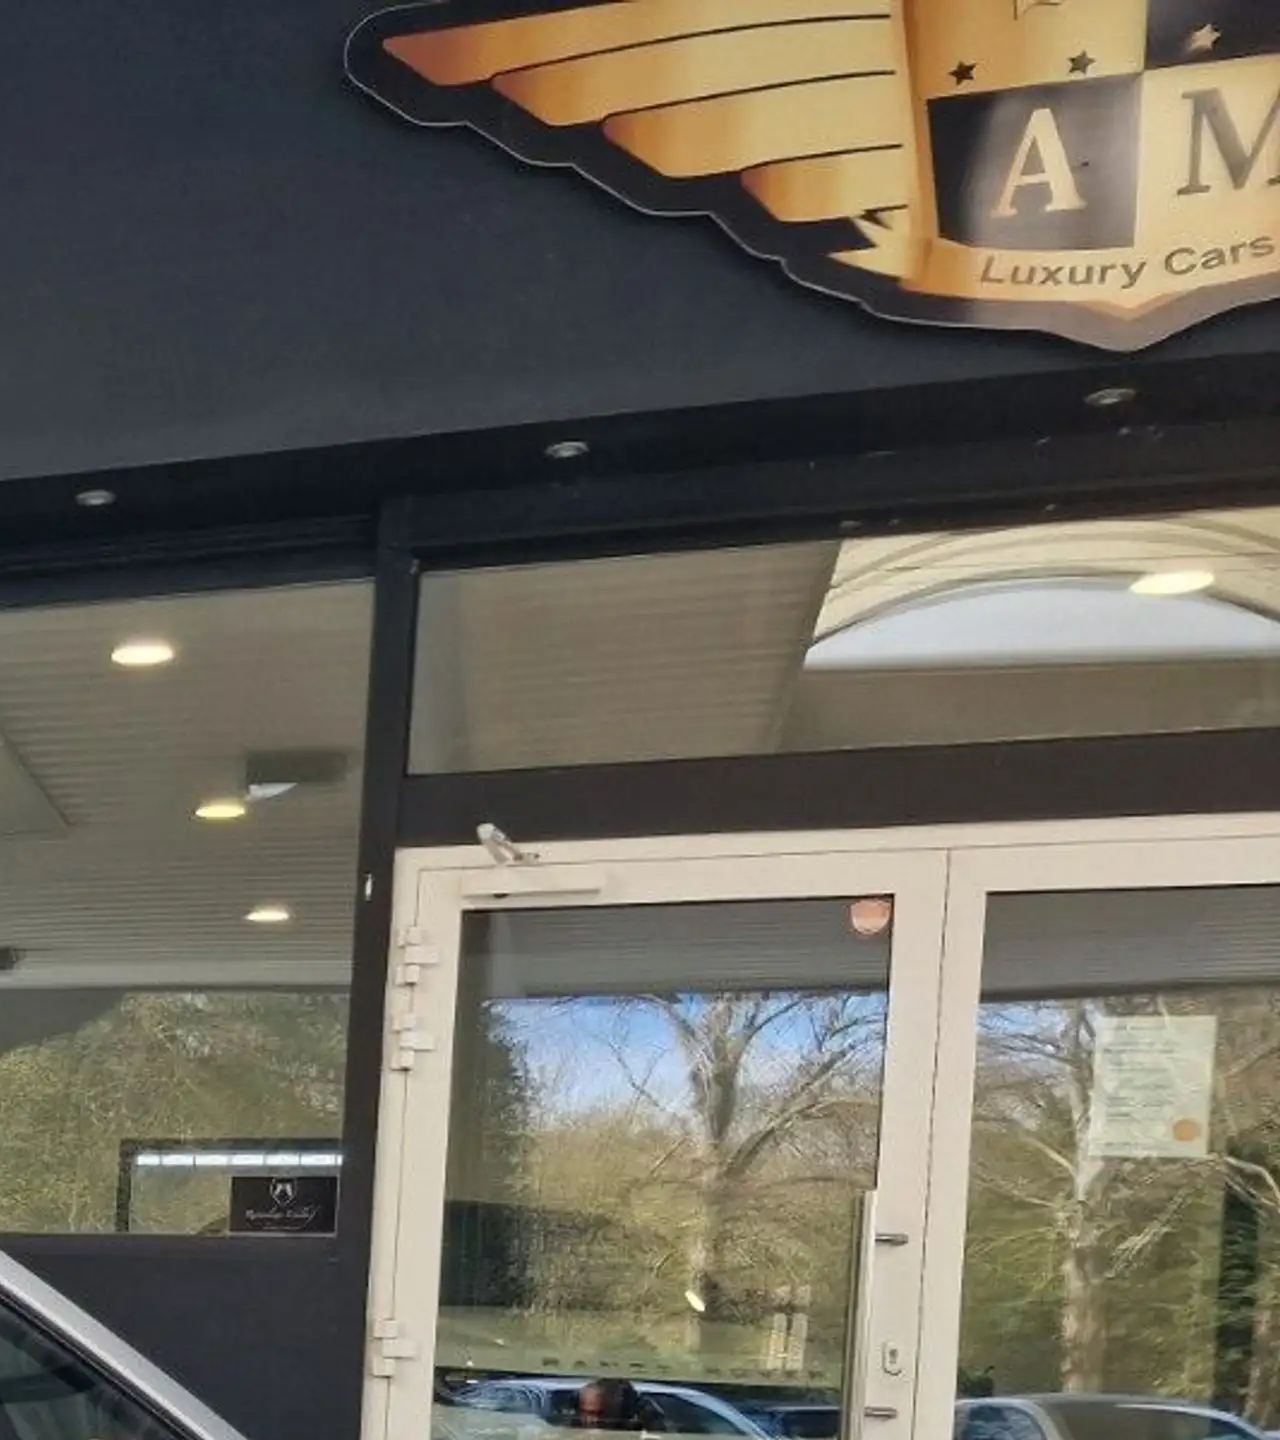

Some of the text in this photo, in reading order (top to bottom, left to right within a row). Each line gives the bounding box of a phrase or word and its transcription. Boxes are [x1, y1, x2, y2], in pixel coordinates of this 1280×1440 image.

[990, 107, 1088, 219] A
[980, 234, 1276, 290] Luxury Cars
